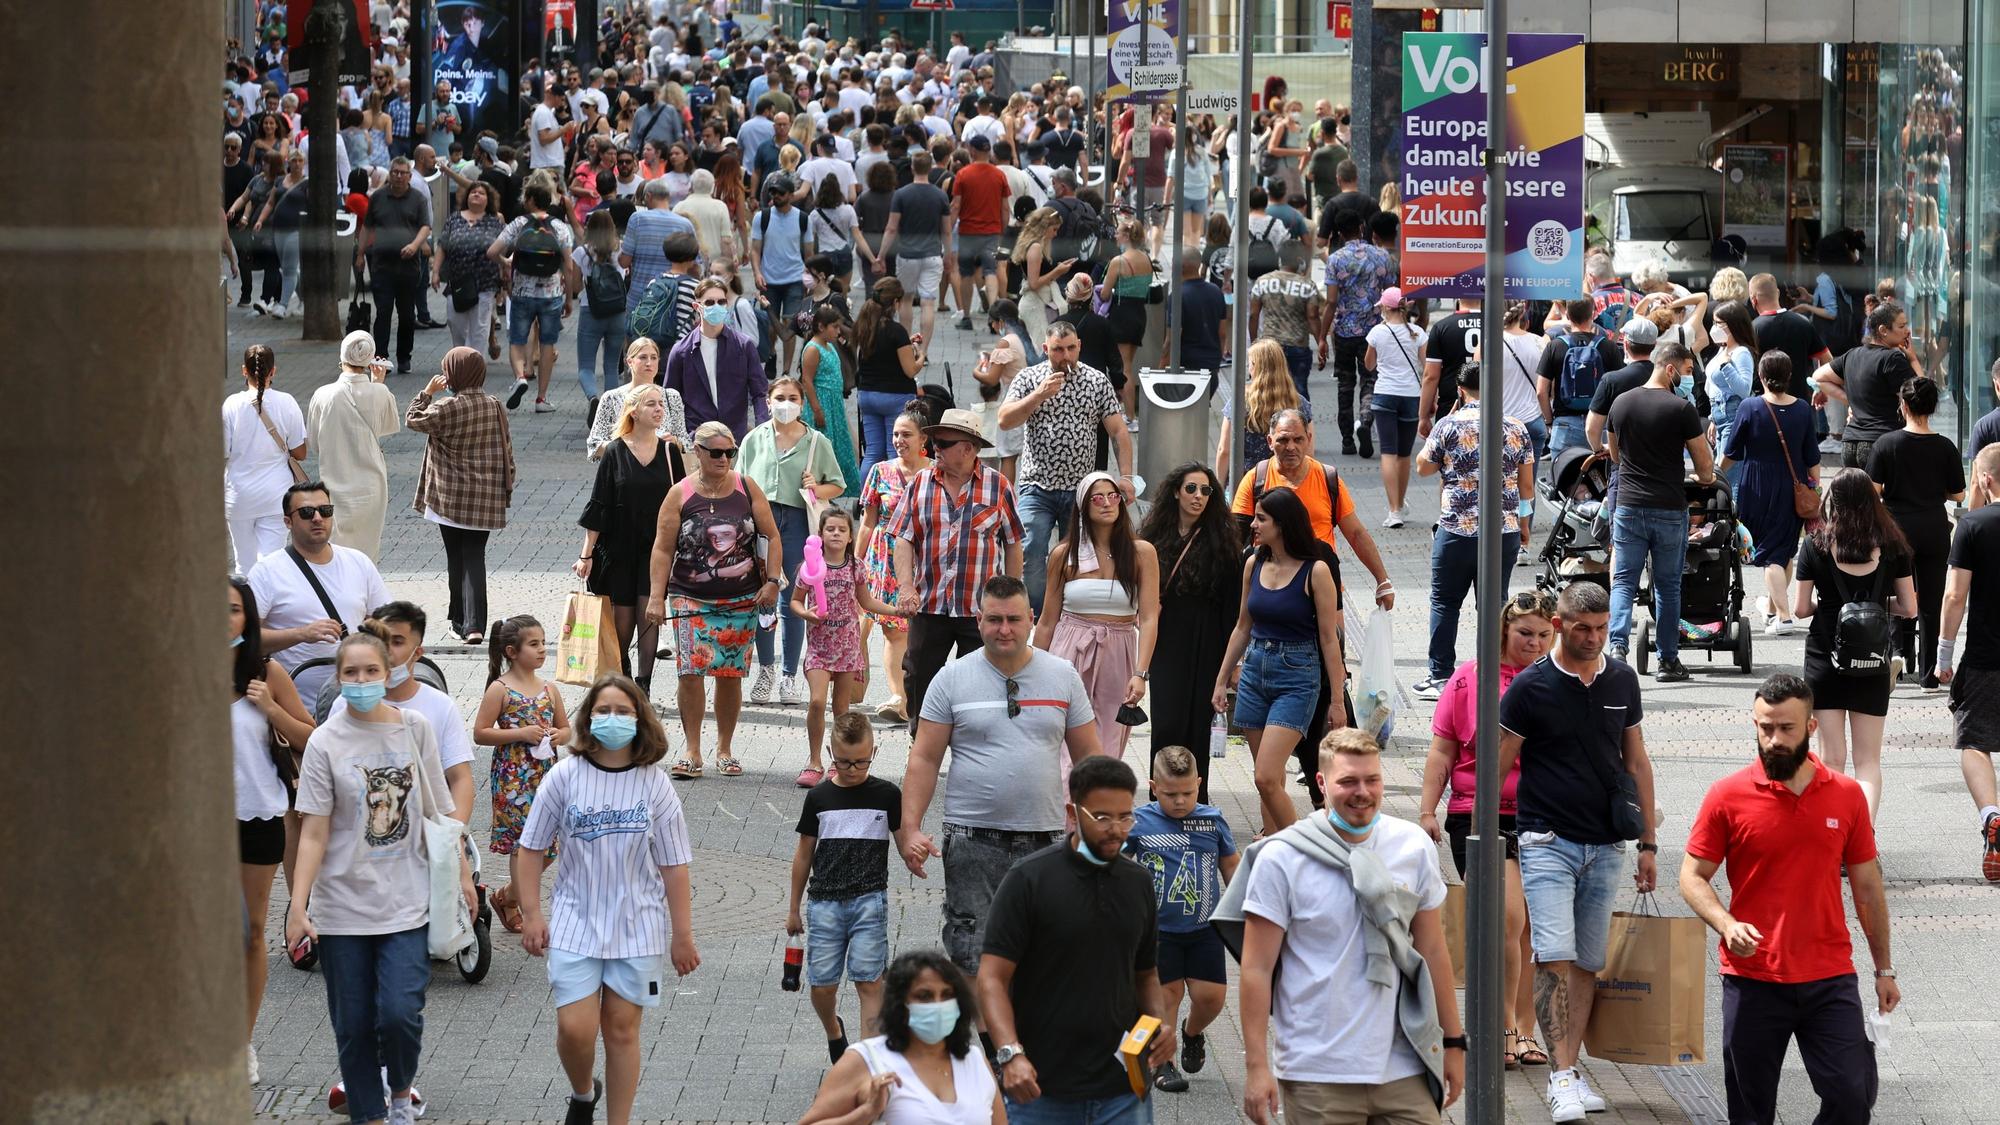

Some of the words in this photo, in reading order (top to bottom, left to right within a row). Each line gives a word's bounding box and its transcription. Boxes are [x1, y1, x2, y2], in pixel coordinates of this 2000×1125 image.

[1118, 41, 1160, 49] Investren
[1132, 50, 1173, 59] Wtschaft
[338, 74, 356, 83] SPD
[465, 69, 496, 79] Meins.
[1664, 62, 1725, 82] BERG
[1134, 71, 1179, 88] Schildergasse
[450, 86, 487, 107] bay
[1188, 94, 1238, 111] Ludwigs
[1406, 115, 1488, 142] Europa
[1405, 173, 1475, 197] heute
[1404, 203, 1509, 226] Zukunf.
[1410, 241, 1483, 250] #GenerationEuropa
[1405, 276, 1456, 287] ZUKUNFT
[1476, 277, 1510, 287] ME
[1511, 277, 1524, 287] IN
[1526, 278, 1571, 288] EUROPE
[824, 579, 853, 590] ROPICAL
[1850, 658, 1881, 669] PUMA
[567, 799, 648, 832] Originals
